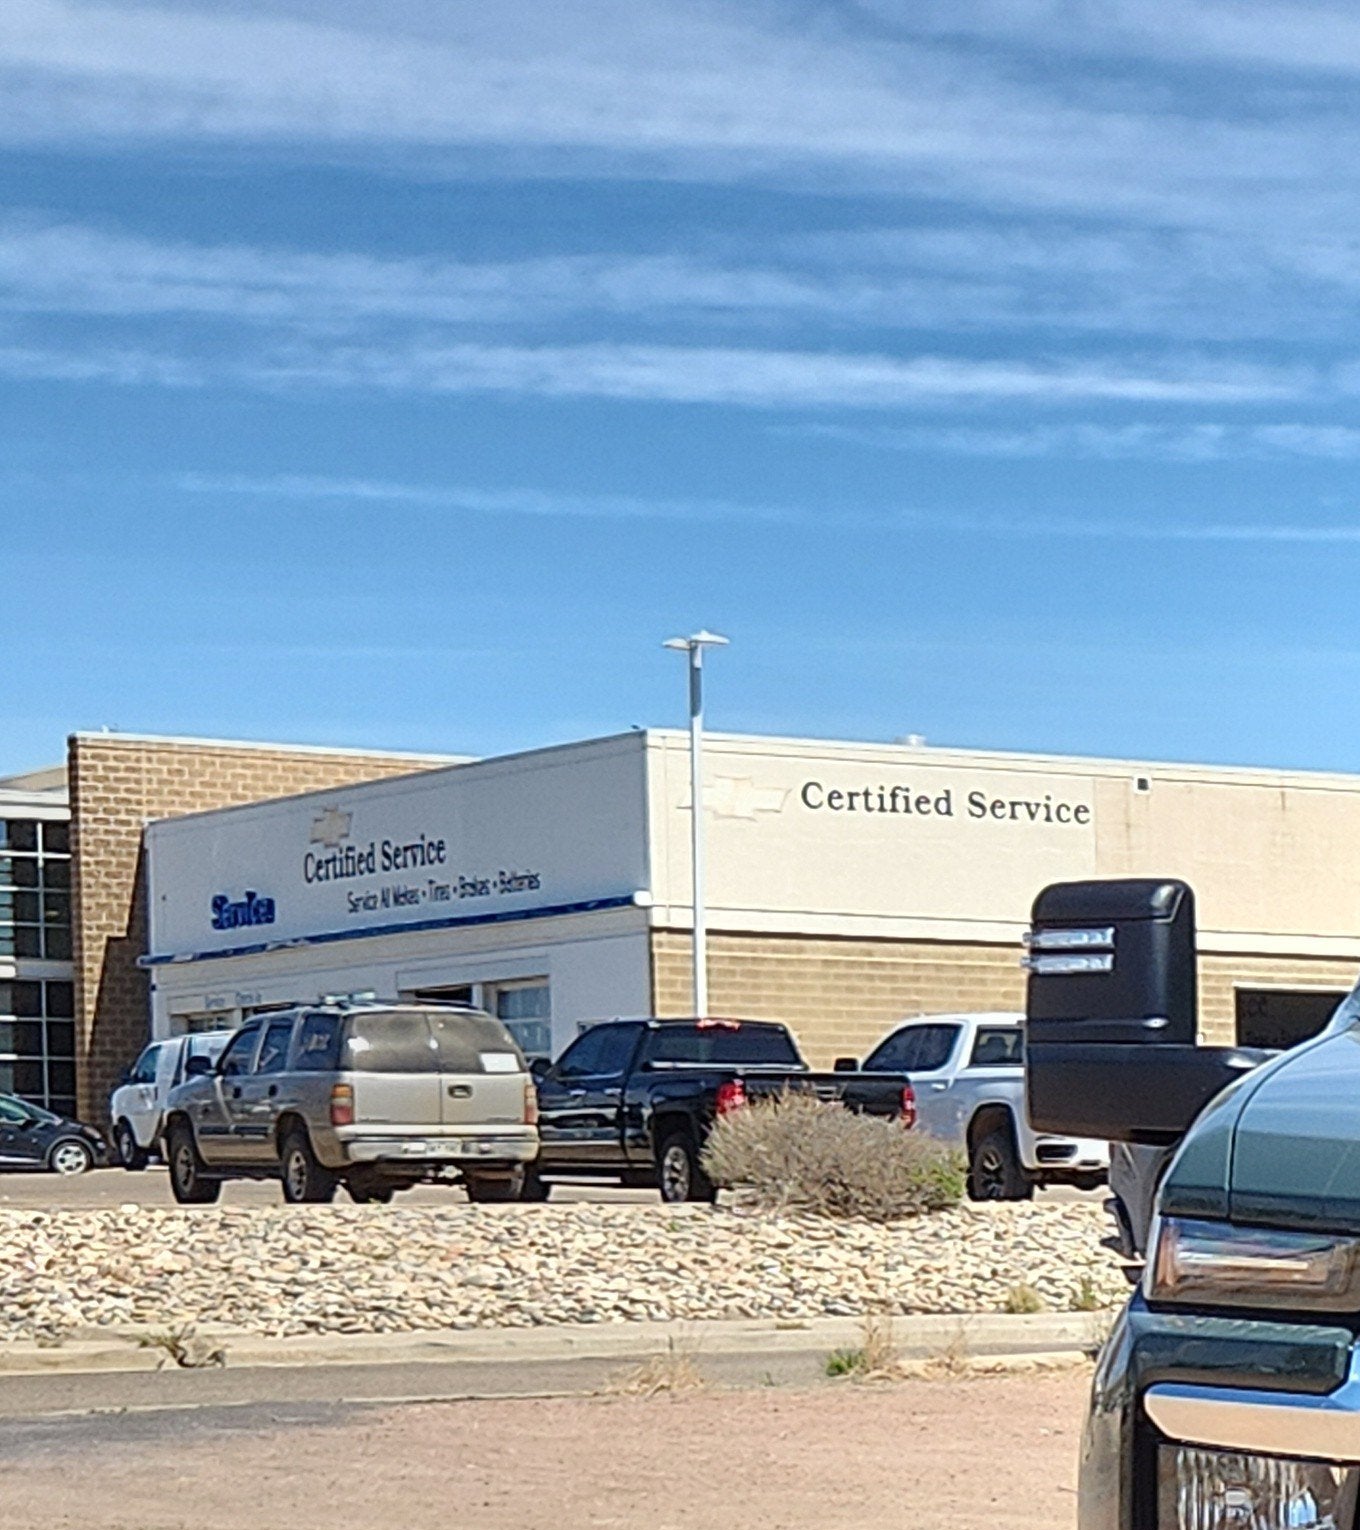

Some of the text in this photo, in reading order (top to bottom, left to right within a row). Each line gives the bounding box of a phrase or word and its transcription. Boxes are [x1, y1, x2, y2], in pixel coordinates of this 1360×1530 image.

[801, 781, 1090, 825] Certified Service
[304, 834, 446, 884] Certified Service
